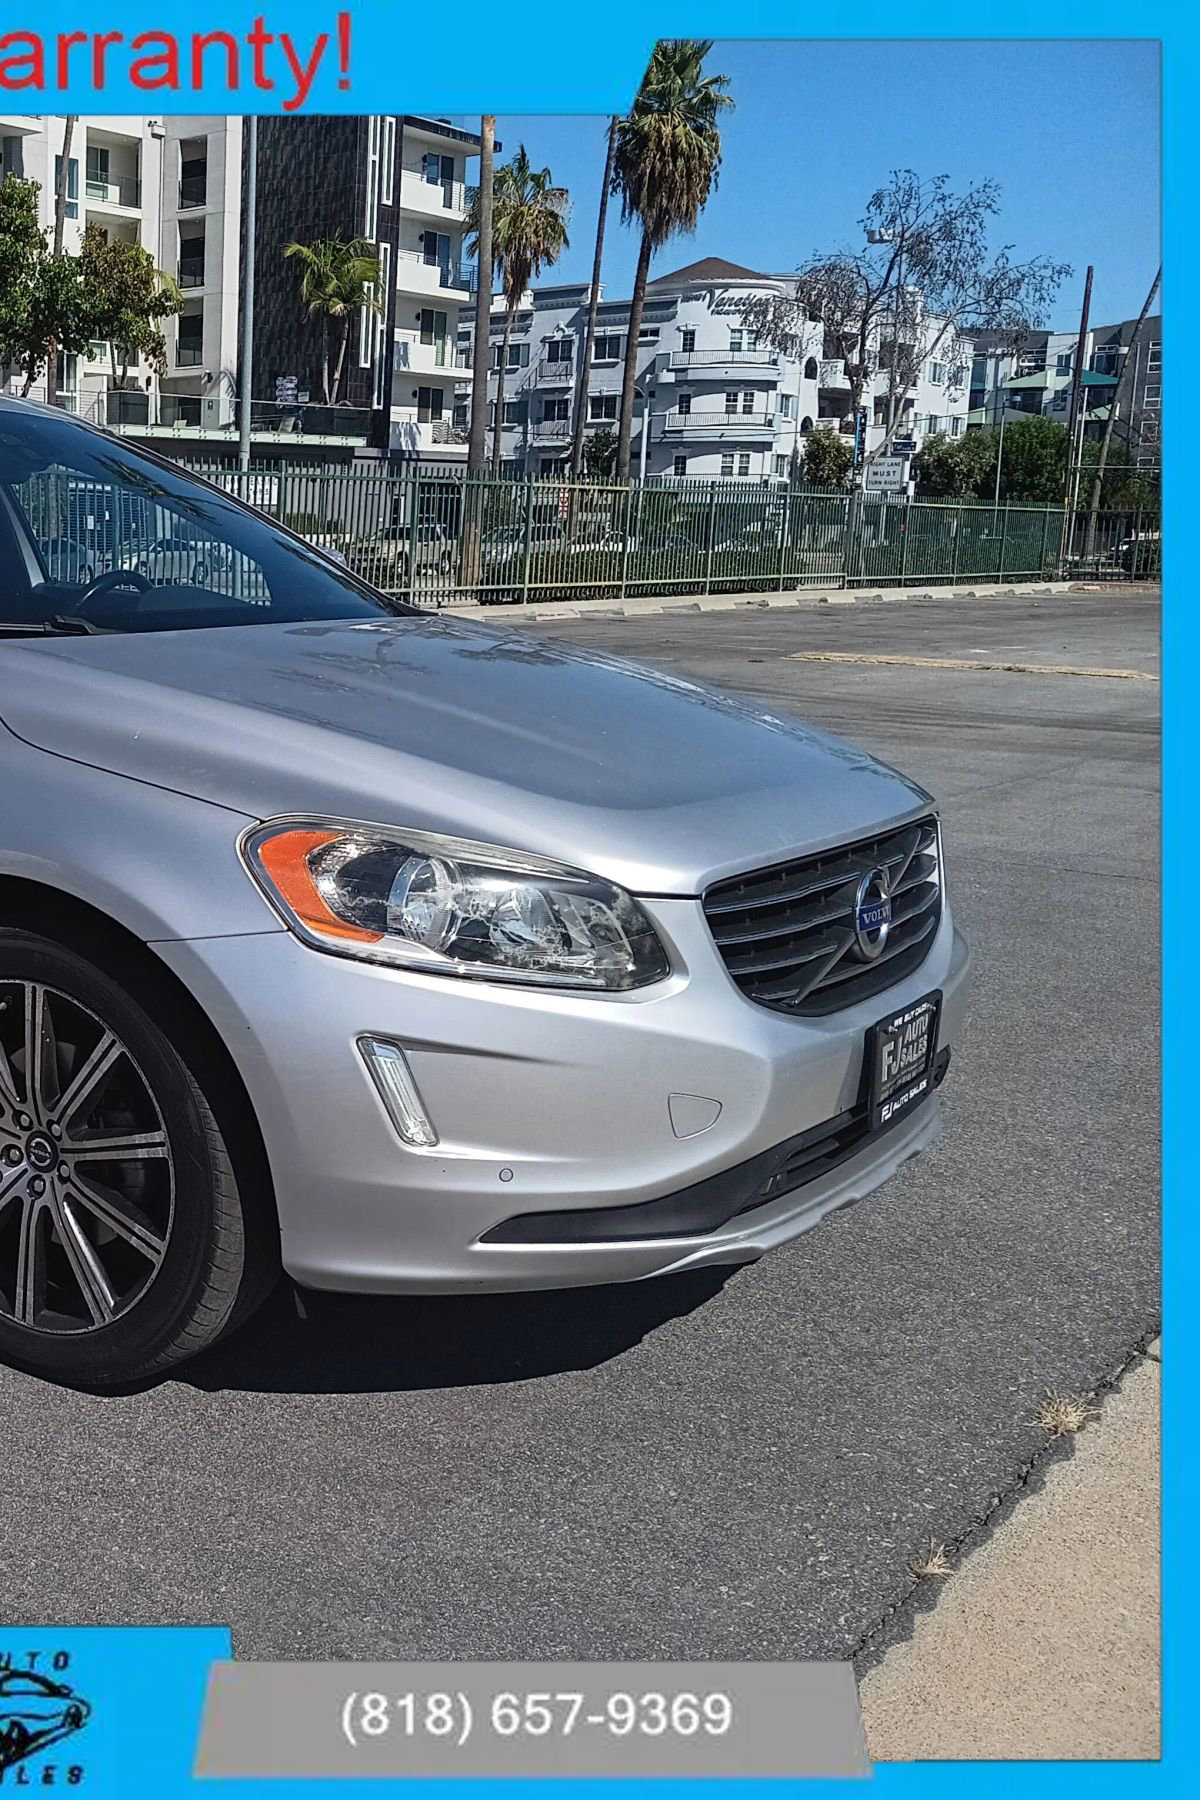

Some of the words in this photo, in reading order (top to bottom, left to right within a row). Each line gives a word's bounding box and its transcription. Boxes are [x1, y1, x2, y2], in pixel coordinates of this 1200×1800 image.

[862, 905, 890, 924] VOLV
[881, 1035, 903, 1082] FJ
[904, 1013, 929, 1045] AUTO
[900, 1034, 928, 1068] SALES
[881, 1102, 893, 1123] FJ
[892, 1092, 909, 1111] AUTO
[909, 1079, 927, 1099] SALES
